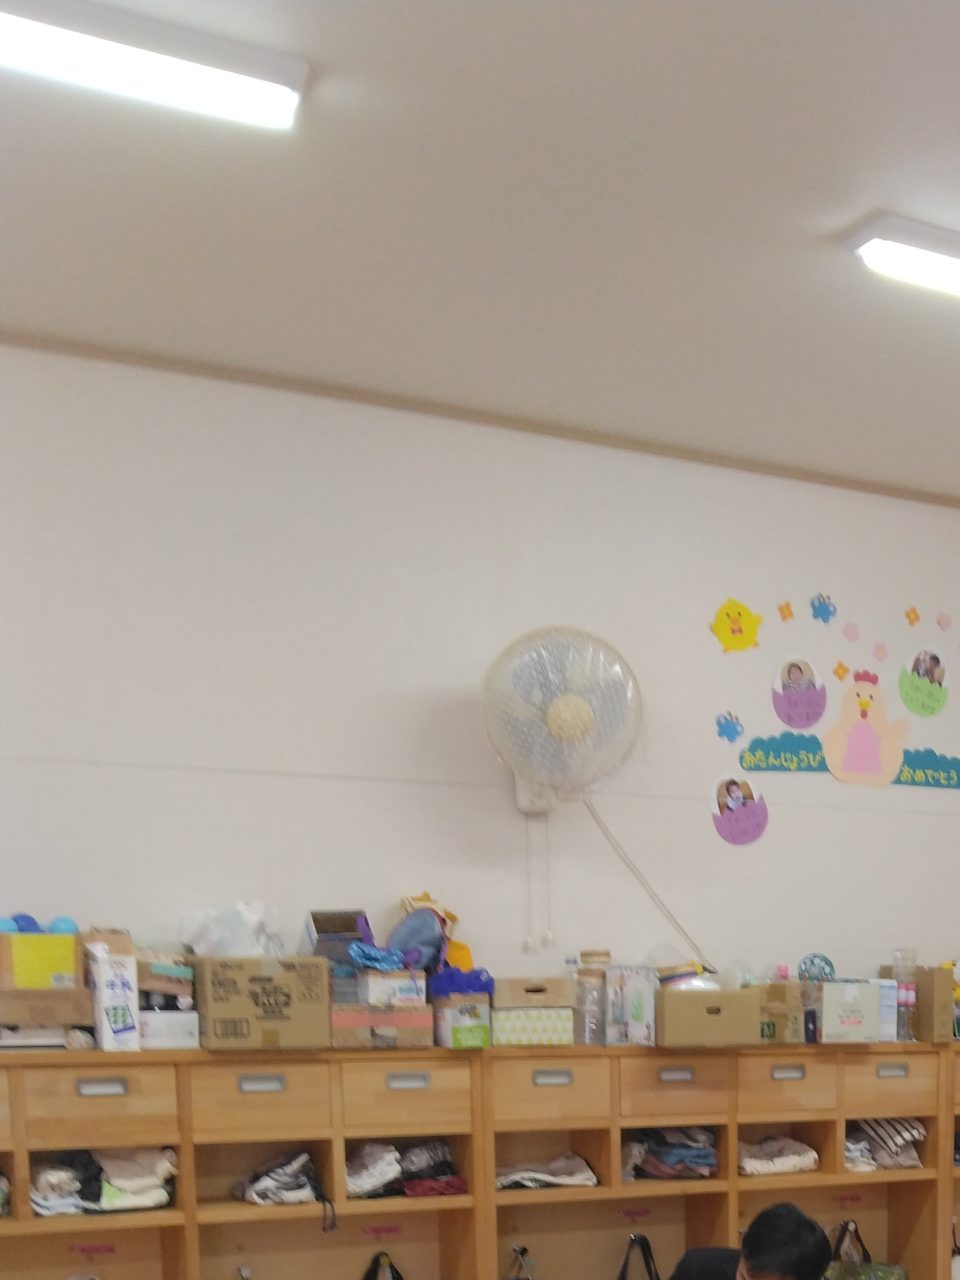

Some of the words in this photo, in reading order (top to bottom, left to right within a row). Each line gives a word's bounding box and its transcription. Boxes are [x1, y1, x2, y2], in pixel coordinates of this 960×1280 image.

[900, 765, 958, 785] おめでとう
